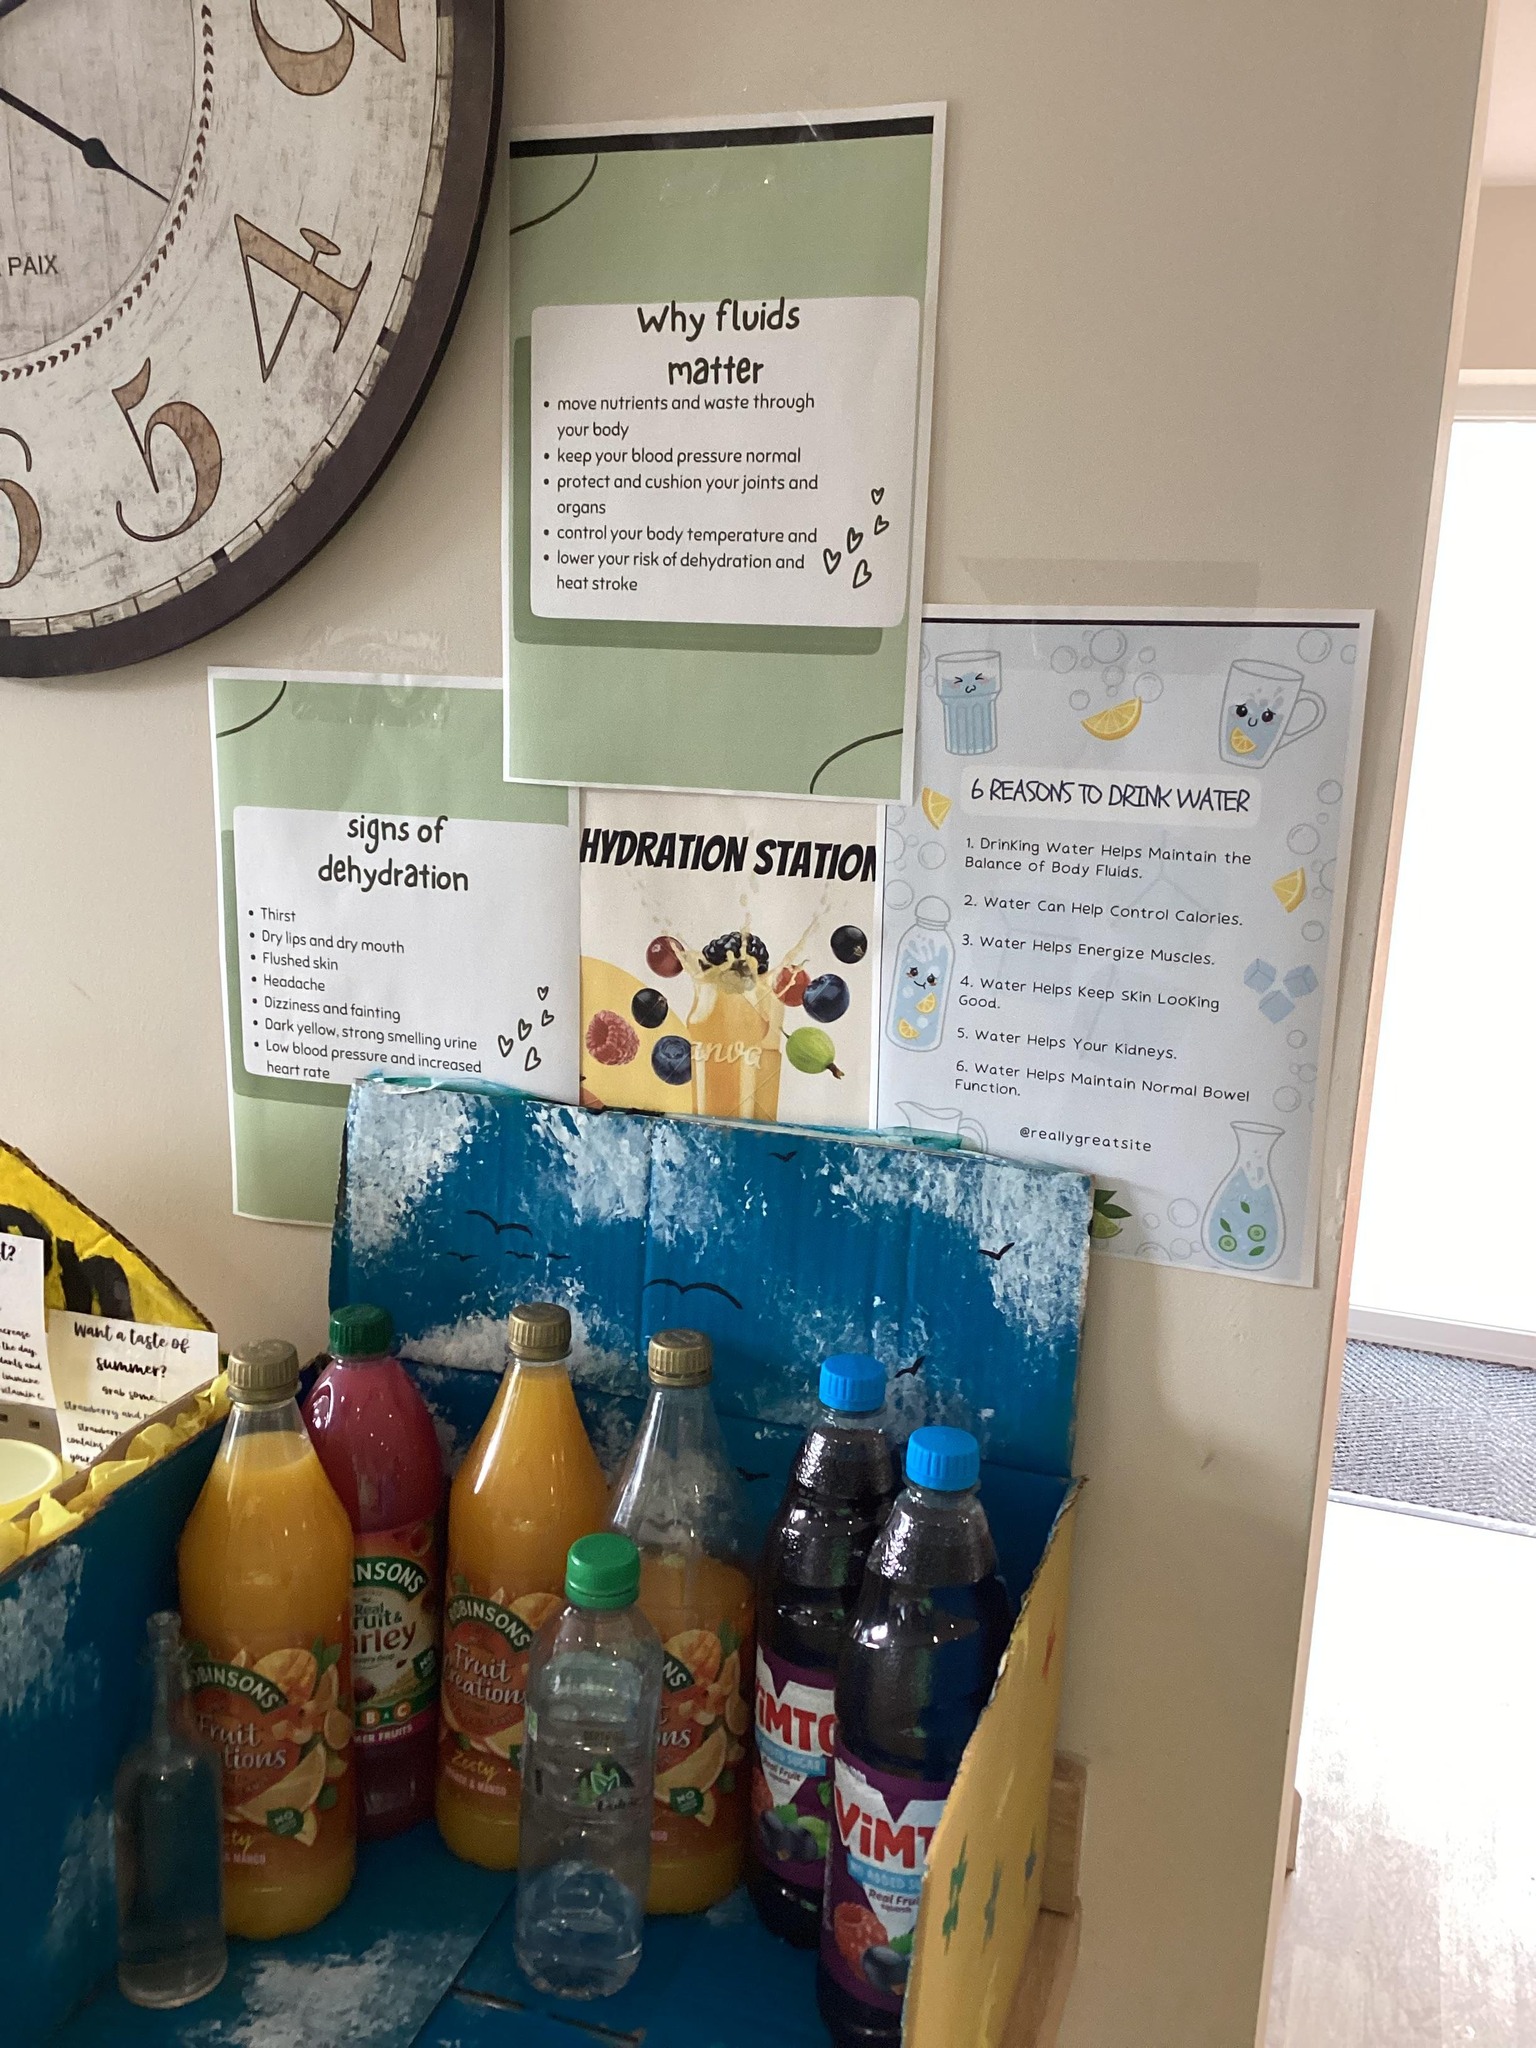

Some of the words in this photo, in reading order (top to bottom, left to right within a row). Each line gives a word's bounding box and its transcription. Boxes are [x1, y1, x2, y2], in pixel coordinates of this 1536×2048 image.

[7, 254, 59, 277] PAIX
[233, 212, 374, 383] 4
[636, 299, 706, 343] Why
[715, 295, 800, 332] fluids
[667, 355, 765, 386] matter
[557, 399, 597, 411] move
[600, 395, 668, 411] nutrients
[671, 394, 701, 410] and
[704, 395, 750, 410] waste
[753, 392, 815, 414] through
[556, 425, 590, 441] your
[592, 420, 630, 441] body
[110, 356, 223, 543] 5
[557, 447, 592, 467] keep
[595, 451, 629, 467] your
[631, 447, 674, 463] blood
[676, 451, 743, 468] pressure
[746, 446, 801, 463] normal
[557, 474, 611, 493] protect
[613, 473, 642, 489] and
[644, 473, 702, 490] cushion
[705, 478, 740, 494] your
[741, 474, 785, 495] joints
[788, 473, 819, 490] and
[556, 503, 606, 519] organs
[556, 524, 607, 540] control
[610, 529, 643, 544] your
[646, 525, 684, 546] body
[686, 527, 785, 546] temperature
[787, 527, 818, 544] and
[557, 549, 595, 565] lower
[597, 554, 630, 569] your
[633, 550, 660, 567] risk
[662, 551, 678, 567] of
[680, 551, 772, 572] dehydration
[775, 553, 805, 569] and
[556, 574, 589, 590] heat
[591, 575, 638, 592] stroke
[971, 777, 985, 800] 6
[989, 777, 1076, 804] REASONS
[1077, 783, 1103, 805] TO
[1107, 783, 1173, 809] DRINK
[1176, 786, 1251, 813] WATER
[346, 814, 410, 855] signs
[417, 814, 449, 844] of
[579, 827, 750, 873] HYDRATION
[966, 837, 974, 849] 1.
[1046, 841, 1095, 856] Water
[1101, 844, 1143, 861] Helps
[1148, 847, 1217, 863] Maintain
[1224, 850, 1252, 865] the
[317, 853, 469, 893] dehydration
[964, 855, 1022, 871] Balance
[1028, 859, 1046, 873] of
[1051, 861, 1090, 878] Body
[1095, 863, 1143, 879] Fluids.
[260, 906, 297, 923] Thirst
[963, 894, 977, 907] 2.
[983, 896, 1031, 911] Water
[1037, 899, 1066, 913] Can
[1071, 901, 1104, 918] Help
[1109, 905, 1169, 921] Control
[1175, 909, 1243, 926] Calories.
[261, 929, 283, 947] Dry
[285, 930, 307, 949] lips
[309, 934, 334, 948] and
[336, 935, 359, 954] dry
[361, 940, 405, 954] mouth
[961, 933, 974, 946] 3.
[979, 936, 1027, 950] Water
[1032, 939, 1072, 956] Helps
[1078, 943, 1145, 962] Energize
[1150, 948, 1215, 966] Muscles.
[262, 951, 311, 969] Flushed
[312, 955, 339, 971] skin
[263, 973, 326, 992] Headache
[959, 975, 974, 988] 4.
[980, 977, 1027, 992] Water
[1032, 981, 1072, 998] Helps
[1078, 985, 1115, 1003] Keep
[264, 995, 321, 1014] Dizziness
[322, 1002, 348, 1016] and
[350, 1003, 401, 1024] fainting
[958, 994, 1001, 1009] Good.
[264, 1017, 295, 1033] Dark
[296, 1021, 340, 1038] yellow,
[341, 1026, 385, 1045] strong
[387, 1031, 442, 1051] smelling
[443, 1036, 478, 1051] urine
[957, 1027, 969, 1040] 5.
[974, 1029, 1021, 1044] Water
[1027, 1034, 1066, 1050] Helps
[1072, 1037, 1109, 1053] Your
[1114, 1042, 1177, 1061] Kidneys.
[265, 1039, 290, 1054] Low
[292, 1041, 328, 1058] blood
[331, 1048, 388, 1063] pressure
[390, 1053, 416, 1066] and
[418, 1057, 482, 1074] increased
[266, 1060, 301, 1076] heart
[303, 1067, 330, 1080] rate
[955, 1059, 968, 1073] 6.
[974, 1062, 1021, 1078] Water
[1026, 1067, 1065, 1084] Helps
[1071, 1072, 1136, 1090] Maintain
[1141, 1080, 1197, 1097] Normal
[1203, 1085, 1250, 1103] Bowel
[955, 1078, 1021, 1097] Function.
[1019, 1126, 1152, 1152] @reallygreatsite
[74, 1321, 113, 1342] Want
[116, 1331, 127, 1342] a
[130, 1328, 168, 1350] taste
[171, 1338, 190, 1354] of
[354, 1609, 392, 1630] ruit
